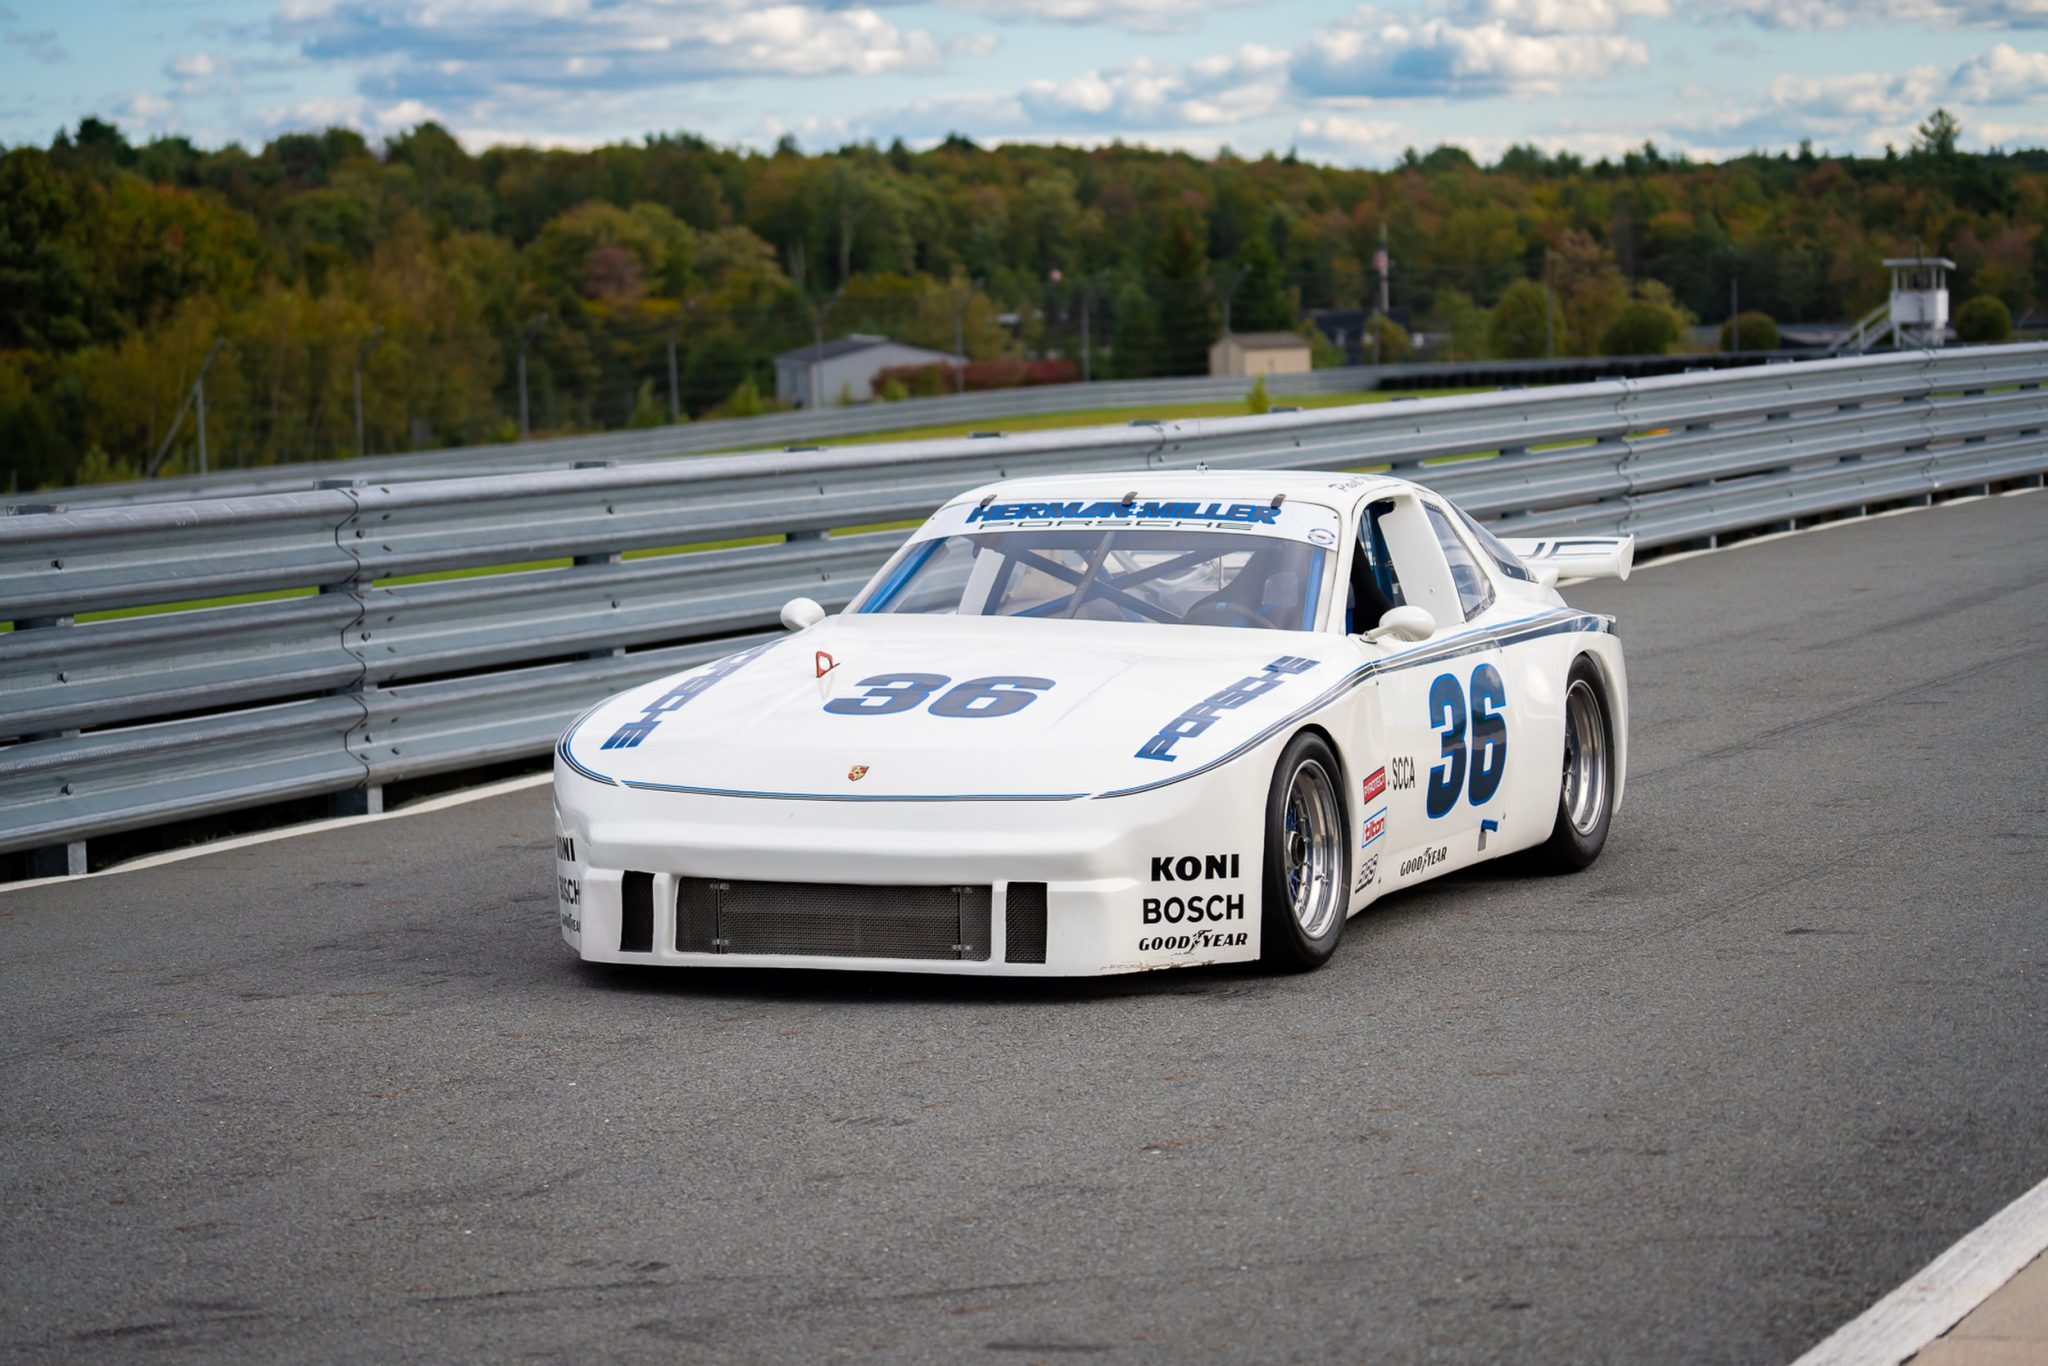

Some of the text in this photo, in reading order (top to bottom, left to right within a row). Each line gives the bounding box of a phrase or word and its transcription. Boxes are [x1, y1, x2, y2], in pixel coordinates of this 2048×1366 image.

[979, 520, 1254, 531] PORSCHE
[823, 672, 1056, 718] 36
[1134, 655, 1321, 762] PORSCHE
[1426, 663, 1508, 820] 36
[1392, 756, 1416, 791] SCCA
[1151, 854, 1240, 882] KONI
[1400, 846, 1448, 877] GOODYEAR
[1142, 894, 1244, 924] BOSCH
[1139, 930, 1248, 953] GOODYEAR
